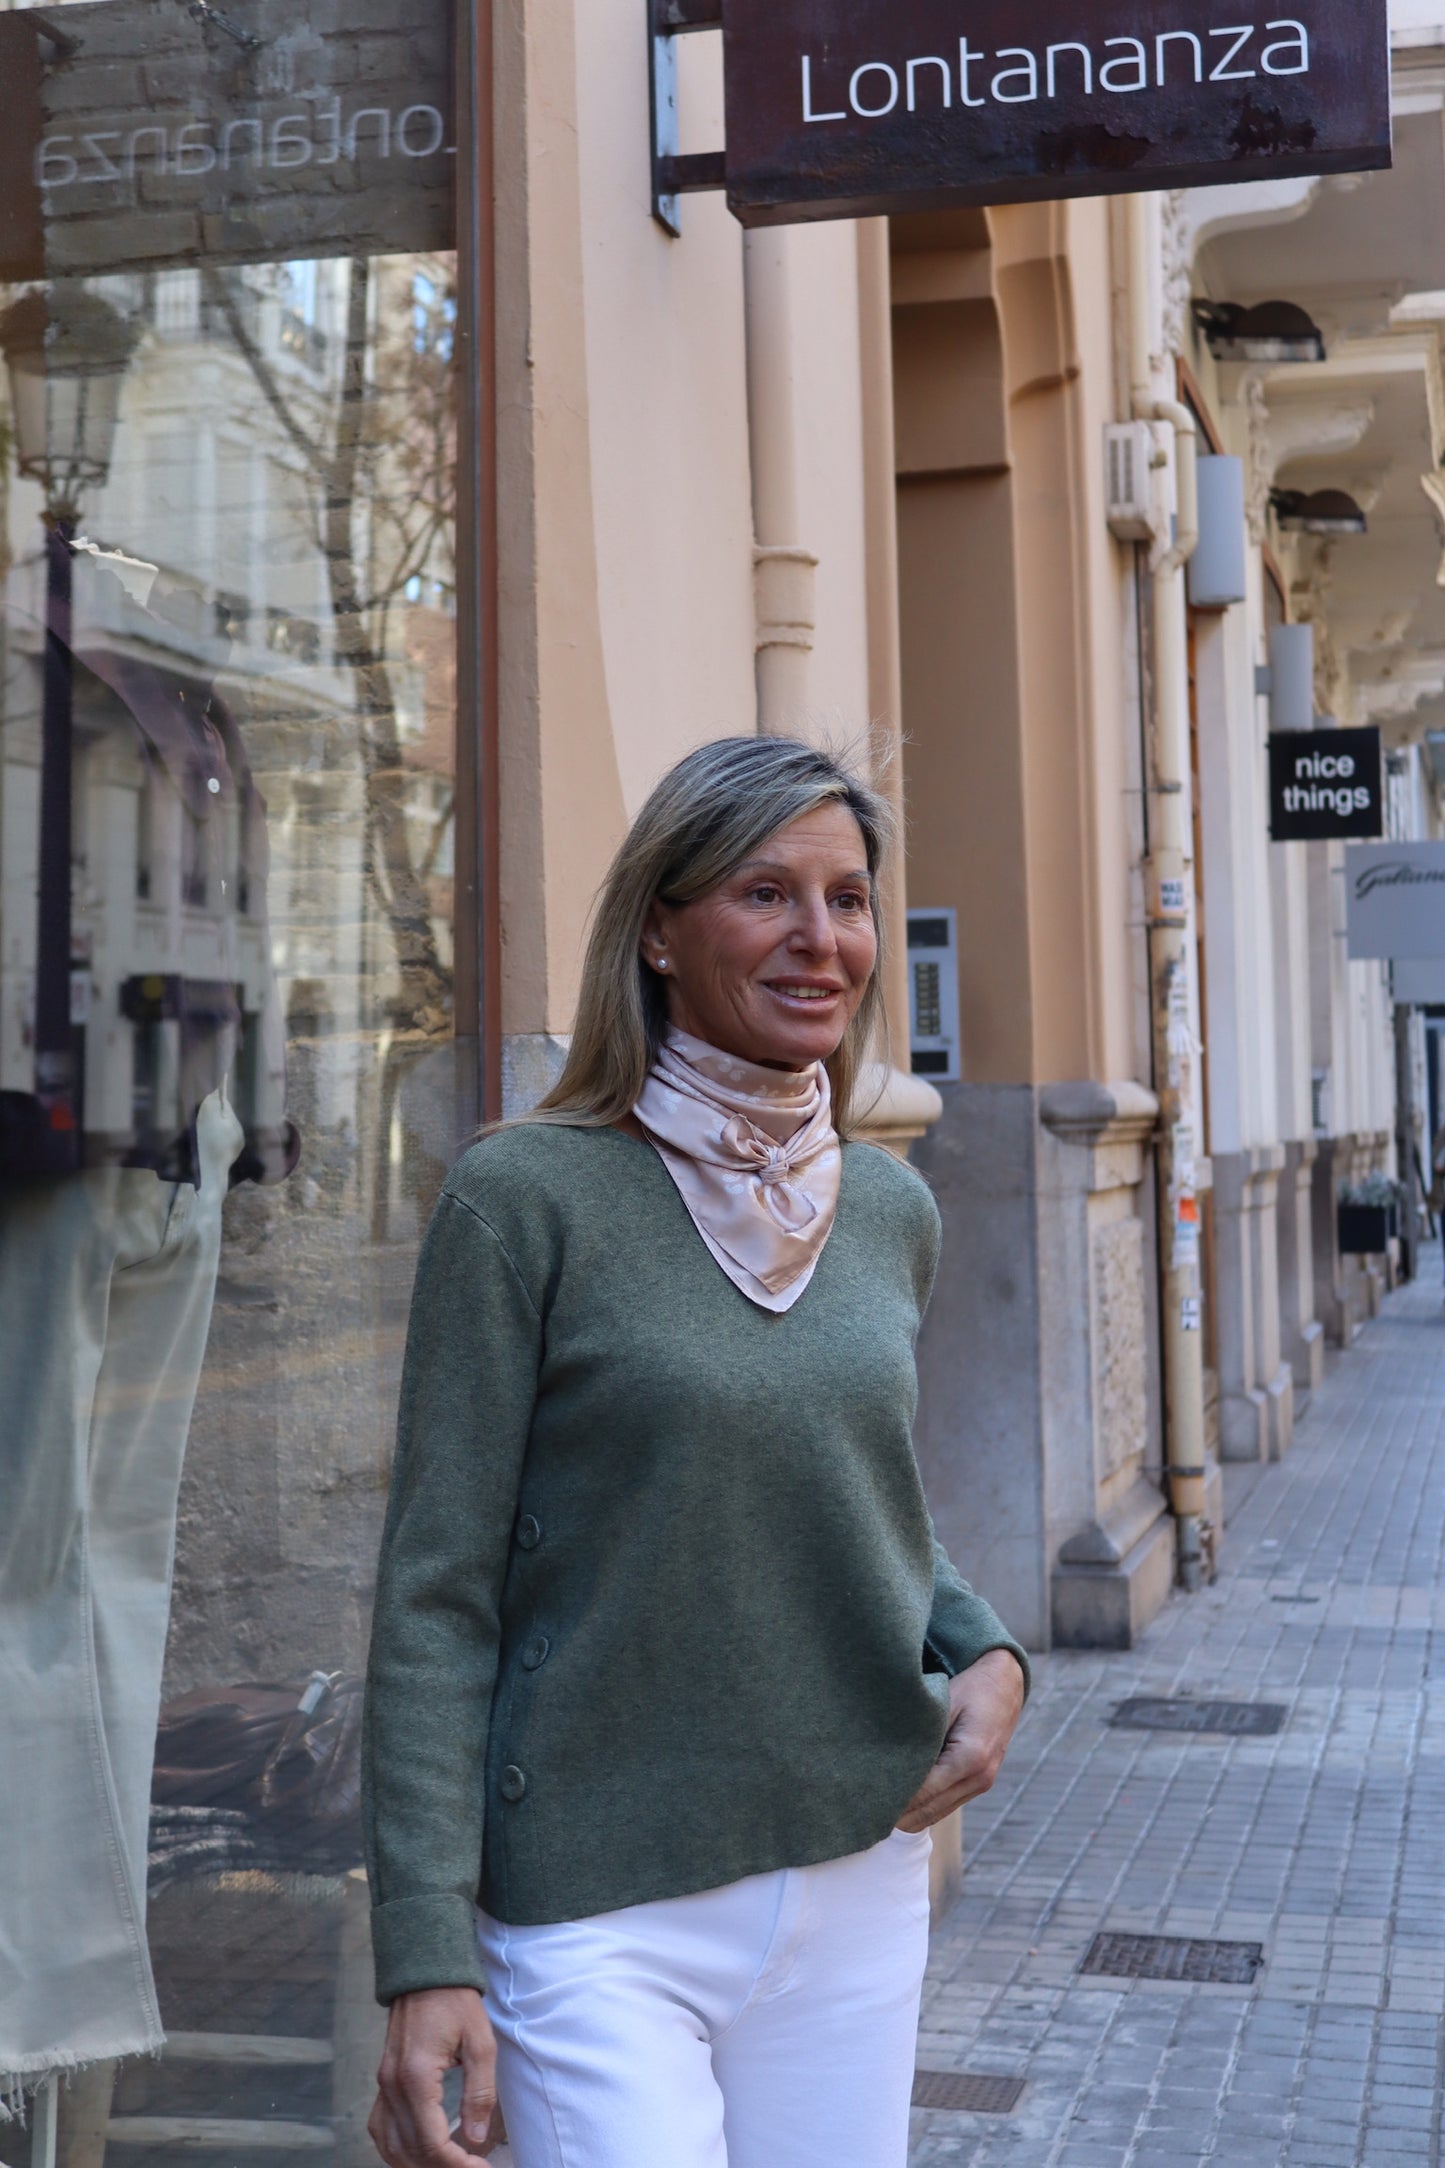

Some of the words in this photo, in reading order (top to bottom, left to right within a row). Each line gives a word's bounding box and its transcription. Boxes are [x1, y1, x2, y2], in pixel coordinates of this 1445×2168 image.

[801, 19, 1310, 123] Lontananza
[1294, 751, 1355, 779] nice
[1282, 784, 1371, 816] things
